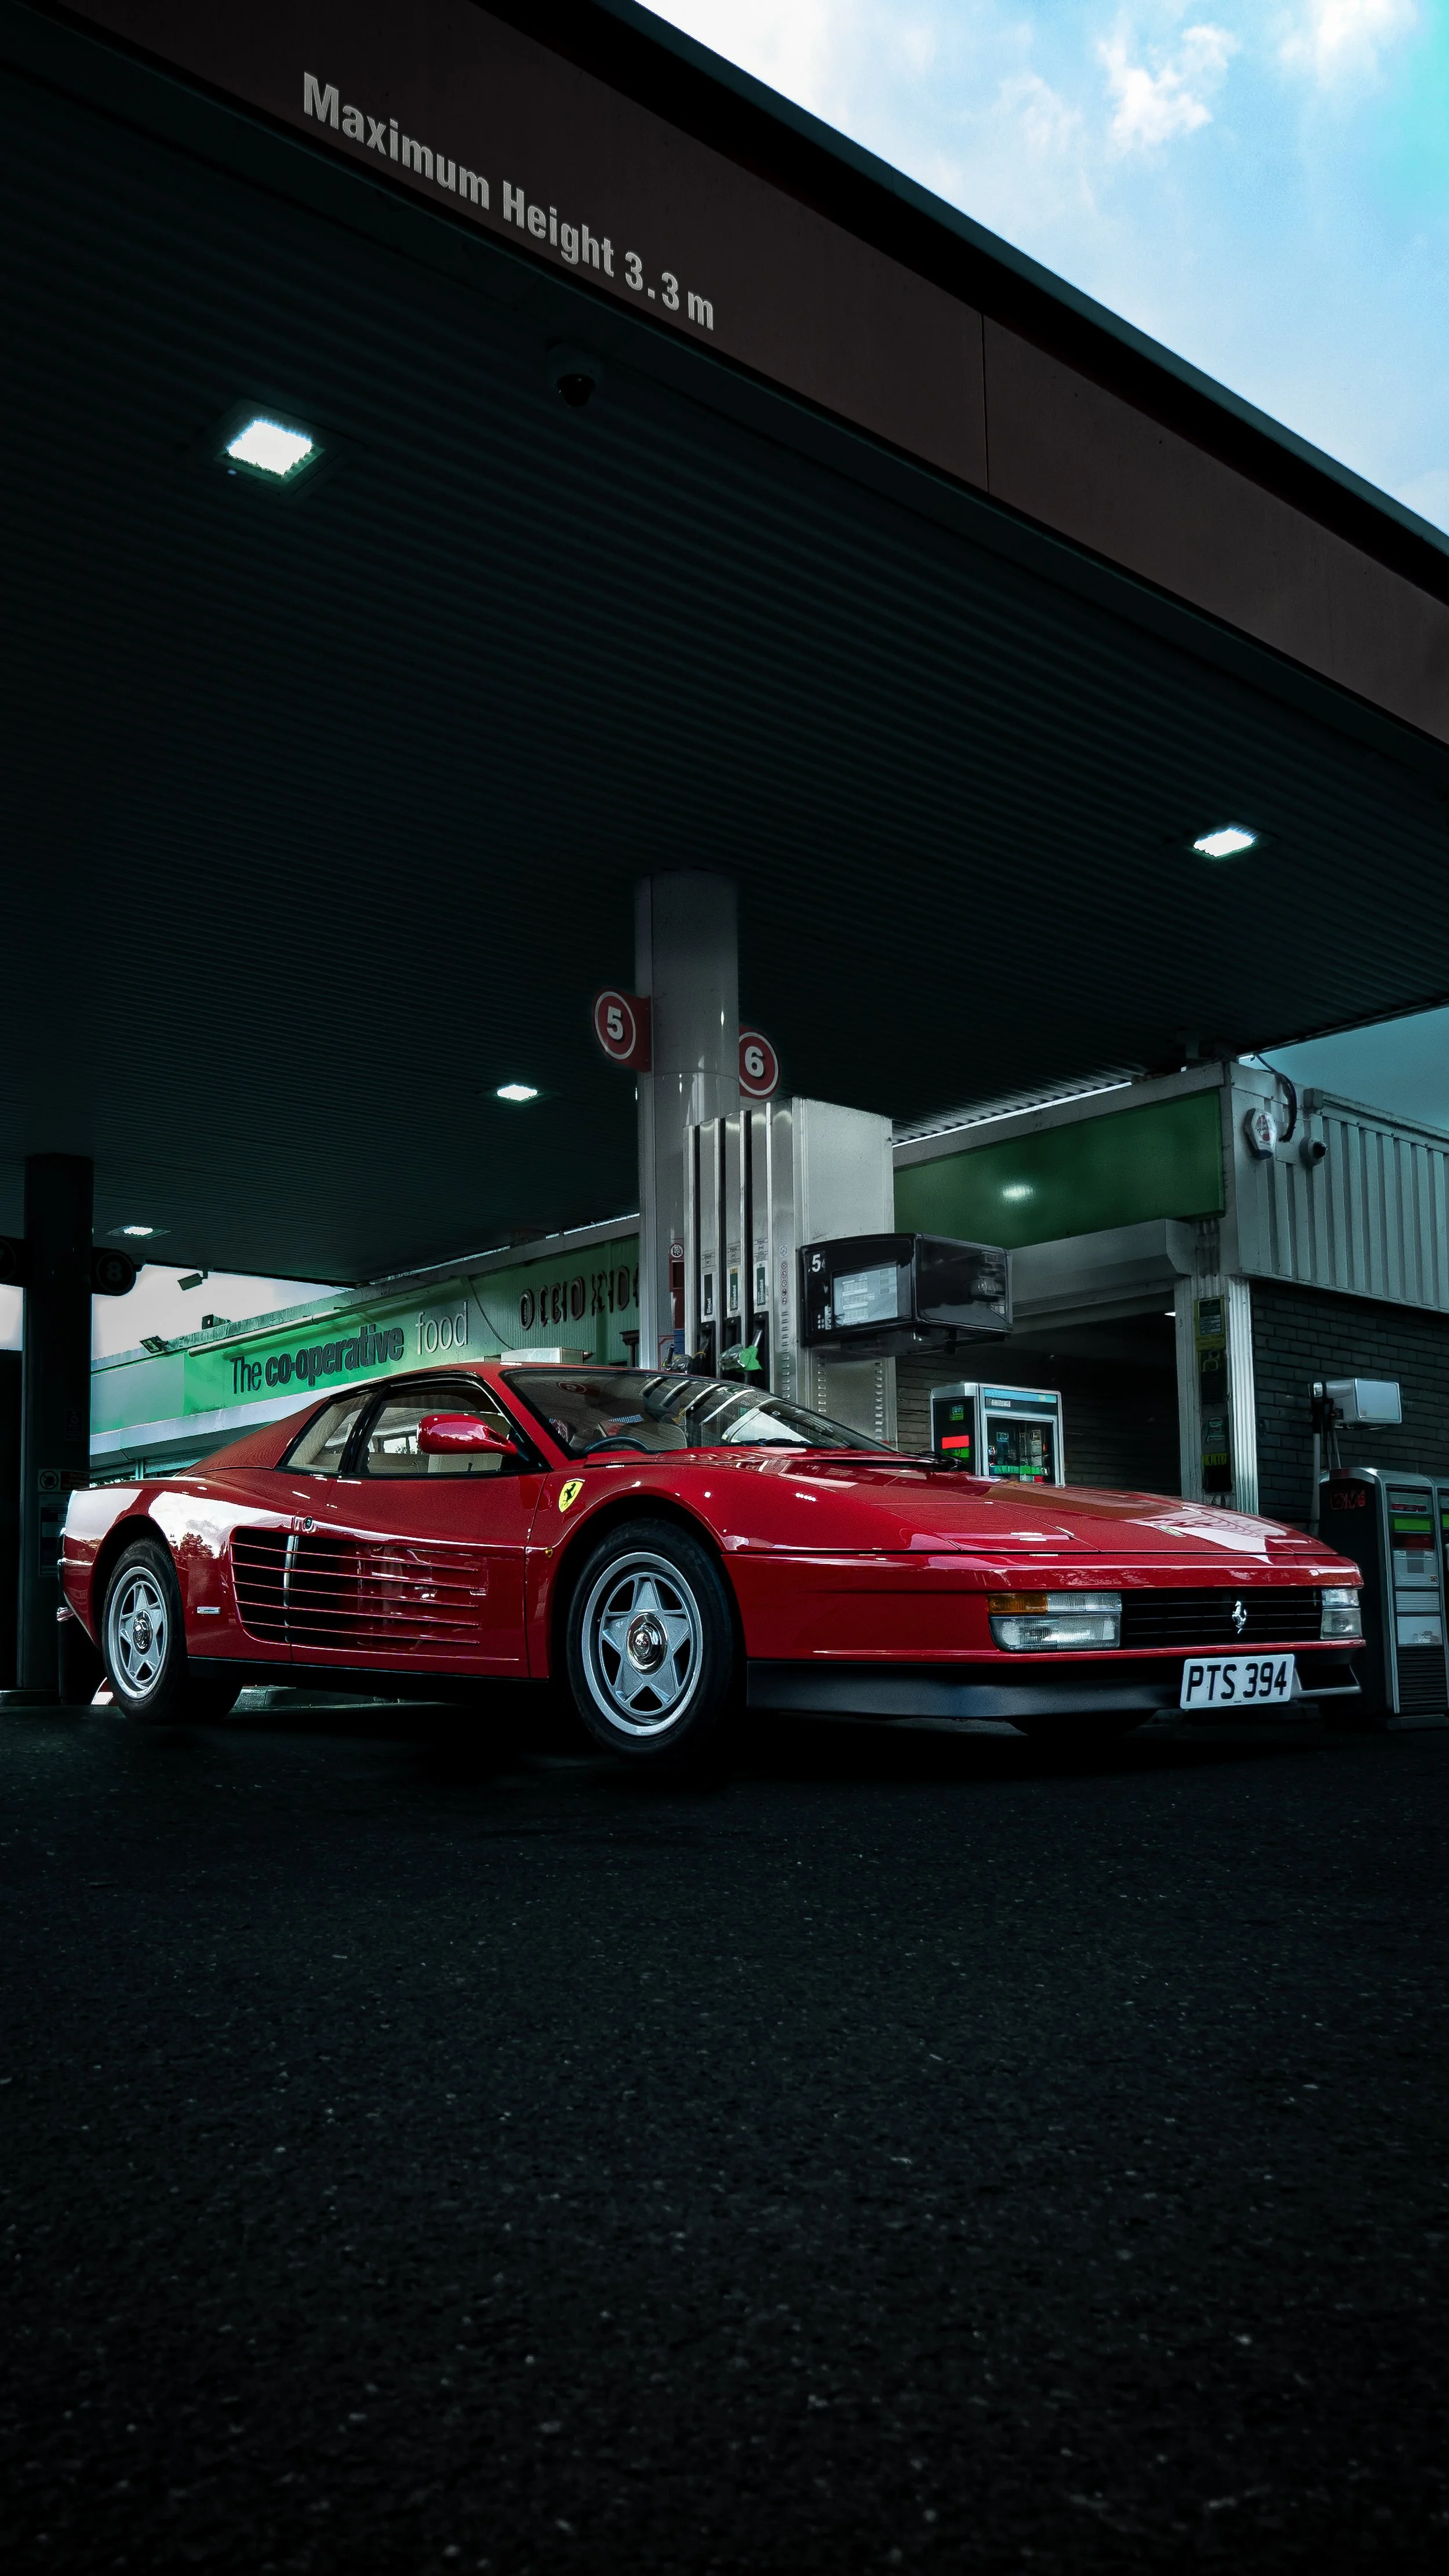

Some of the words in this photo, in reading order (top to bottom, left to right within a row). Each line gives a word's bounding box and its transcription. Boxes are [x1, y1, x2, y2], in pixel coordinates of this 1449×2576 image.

[304, 71, 489, 210] Maximum
[503, 180, 614, 277] Height
[625, 252, 679, 310] 3.3
[688, 291, 713, 330] m
[607, 1006, 624, 1040] 5
[745, 1046, 764, 1077] 6
[106, 1261, 122, 1282] 8
[812, 1254, 821, 1272] 5
[230, 1356, 262, 1394] The
[265, 1323, 404, 1387] co-operative
[416, 1300, 469, 1356] food
[1186, 1664, 1237, 1702] PTS
[1243, 1661, 1287, 1698] 394
